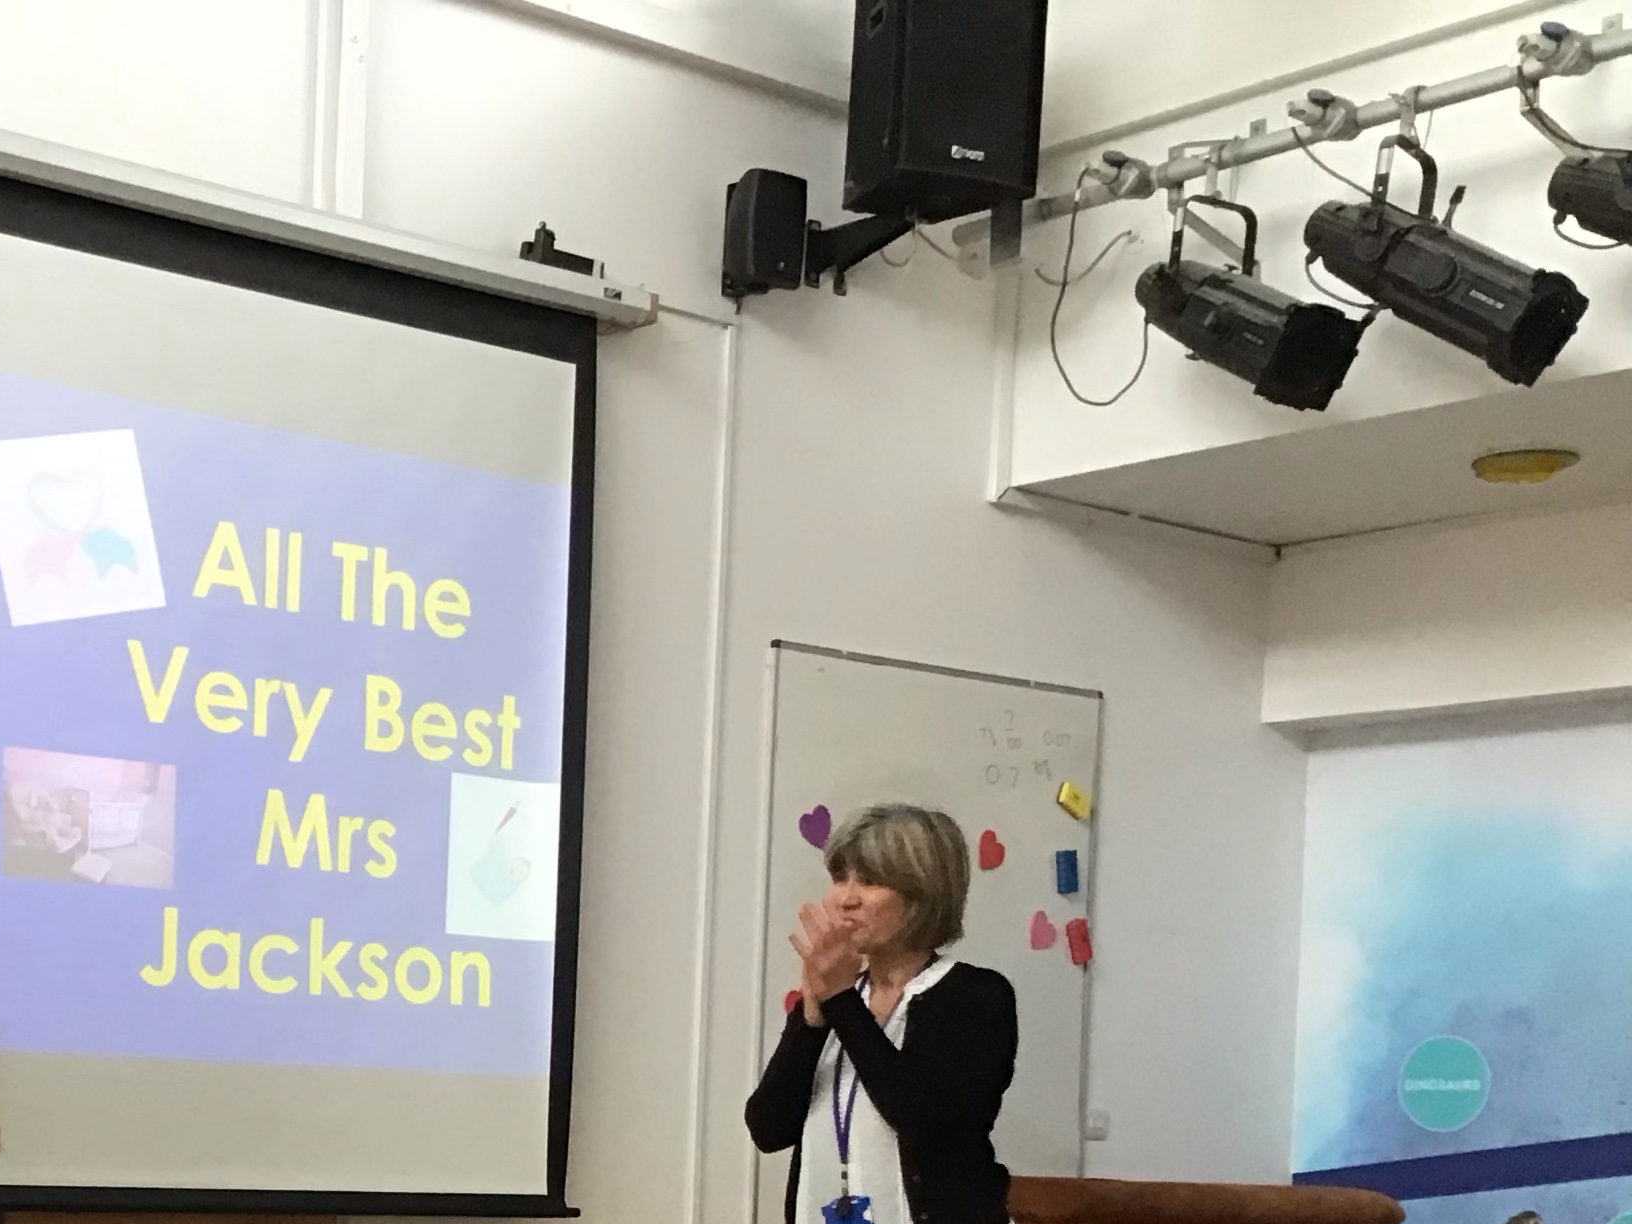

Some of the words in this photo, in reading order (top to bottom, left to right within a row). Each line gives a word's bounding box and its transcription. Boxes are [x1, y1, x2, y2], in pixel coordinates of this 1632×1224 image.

[193, 521, 302, 611] All
[331, 541, 471, 638] The
[127, 639, 332, 762] Very
[364, 674, 521, 770] Best
[255, 789, 397, 878] Mrs
[140, 907, 491, 1007] Jackson
